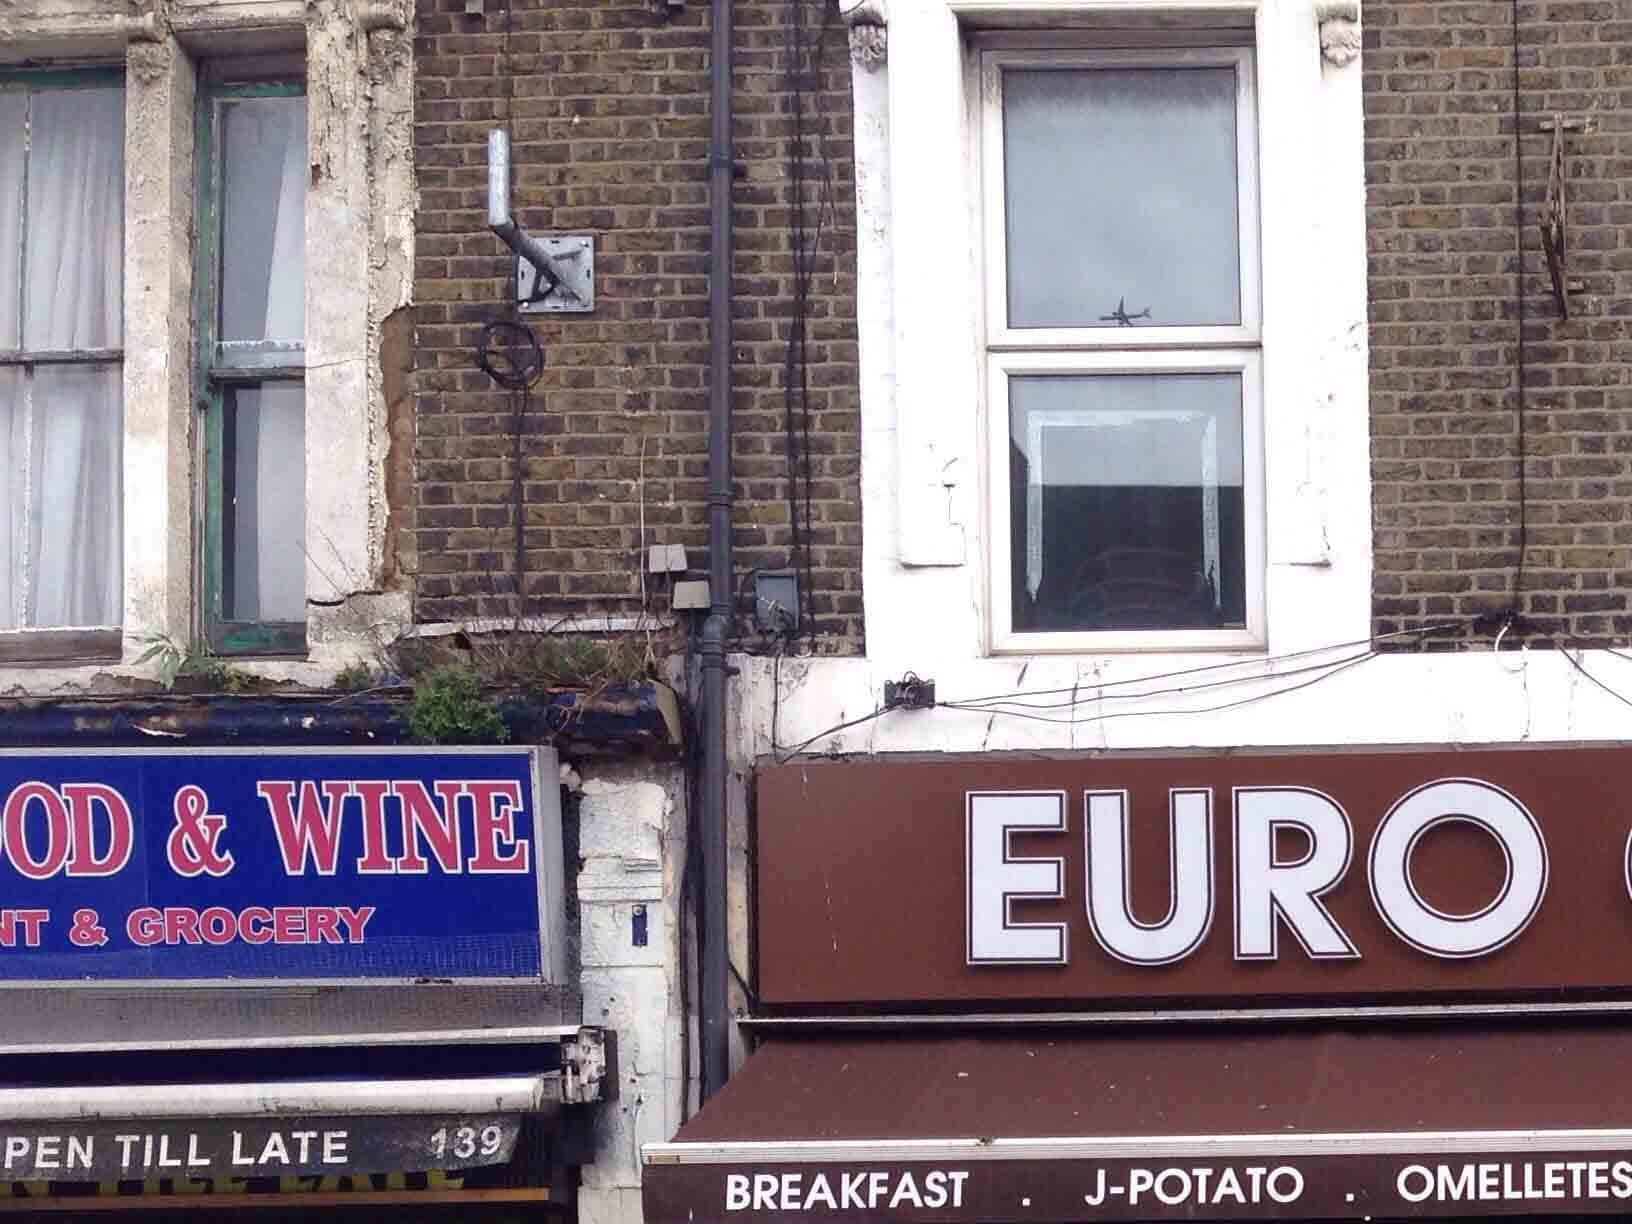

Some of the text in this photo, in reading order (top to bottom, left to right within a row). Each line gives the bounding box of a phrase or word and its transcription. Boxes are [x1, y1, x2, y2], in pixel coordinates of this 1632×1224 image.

[167, 784, 234, 877] &
[257, 779, 529, 876] WINE
[965, 776, 1549, 967] EURO
[69, 908, 109, 946] &
[127, 906, 375, 945] GROCERY
[4, 1126, 502, 1168] PEN TILL LATE 139
[725, 1171, 968, 1210] BREAKFAST
[1084, 1166, 1304, 1206] J-POTATO
